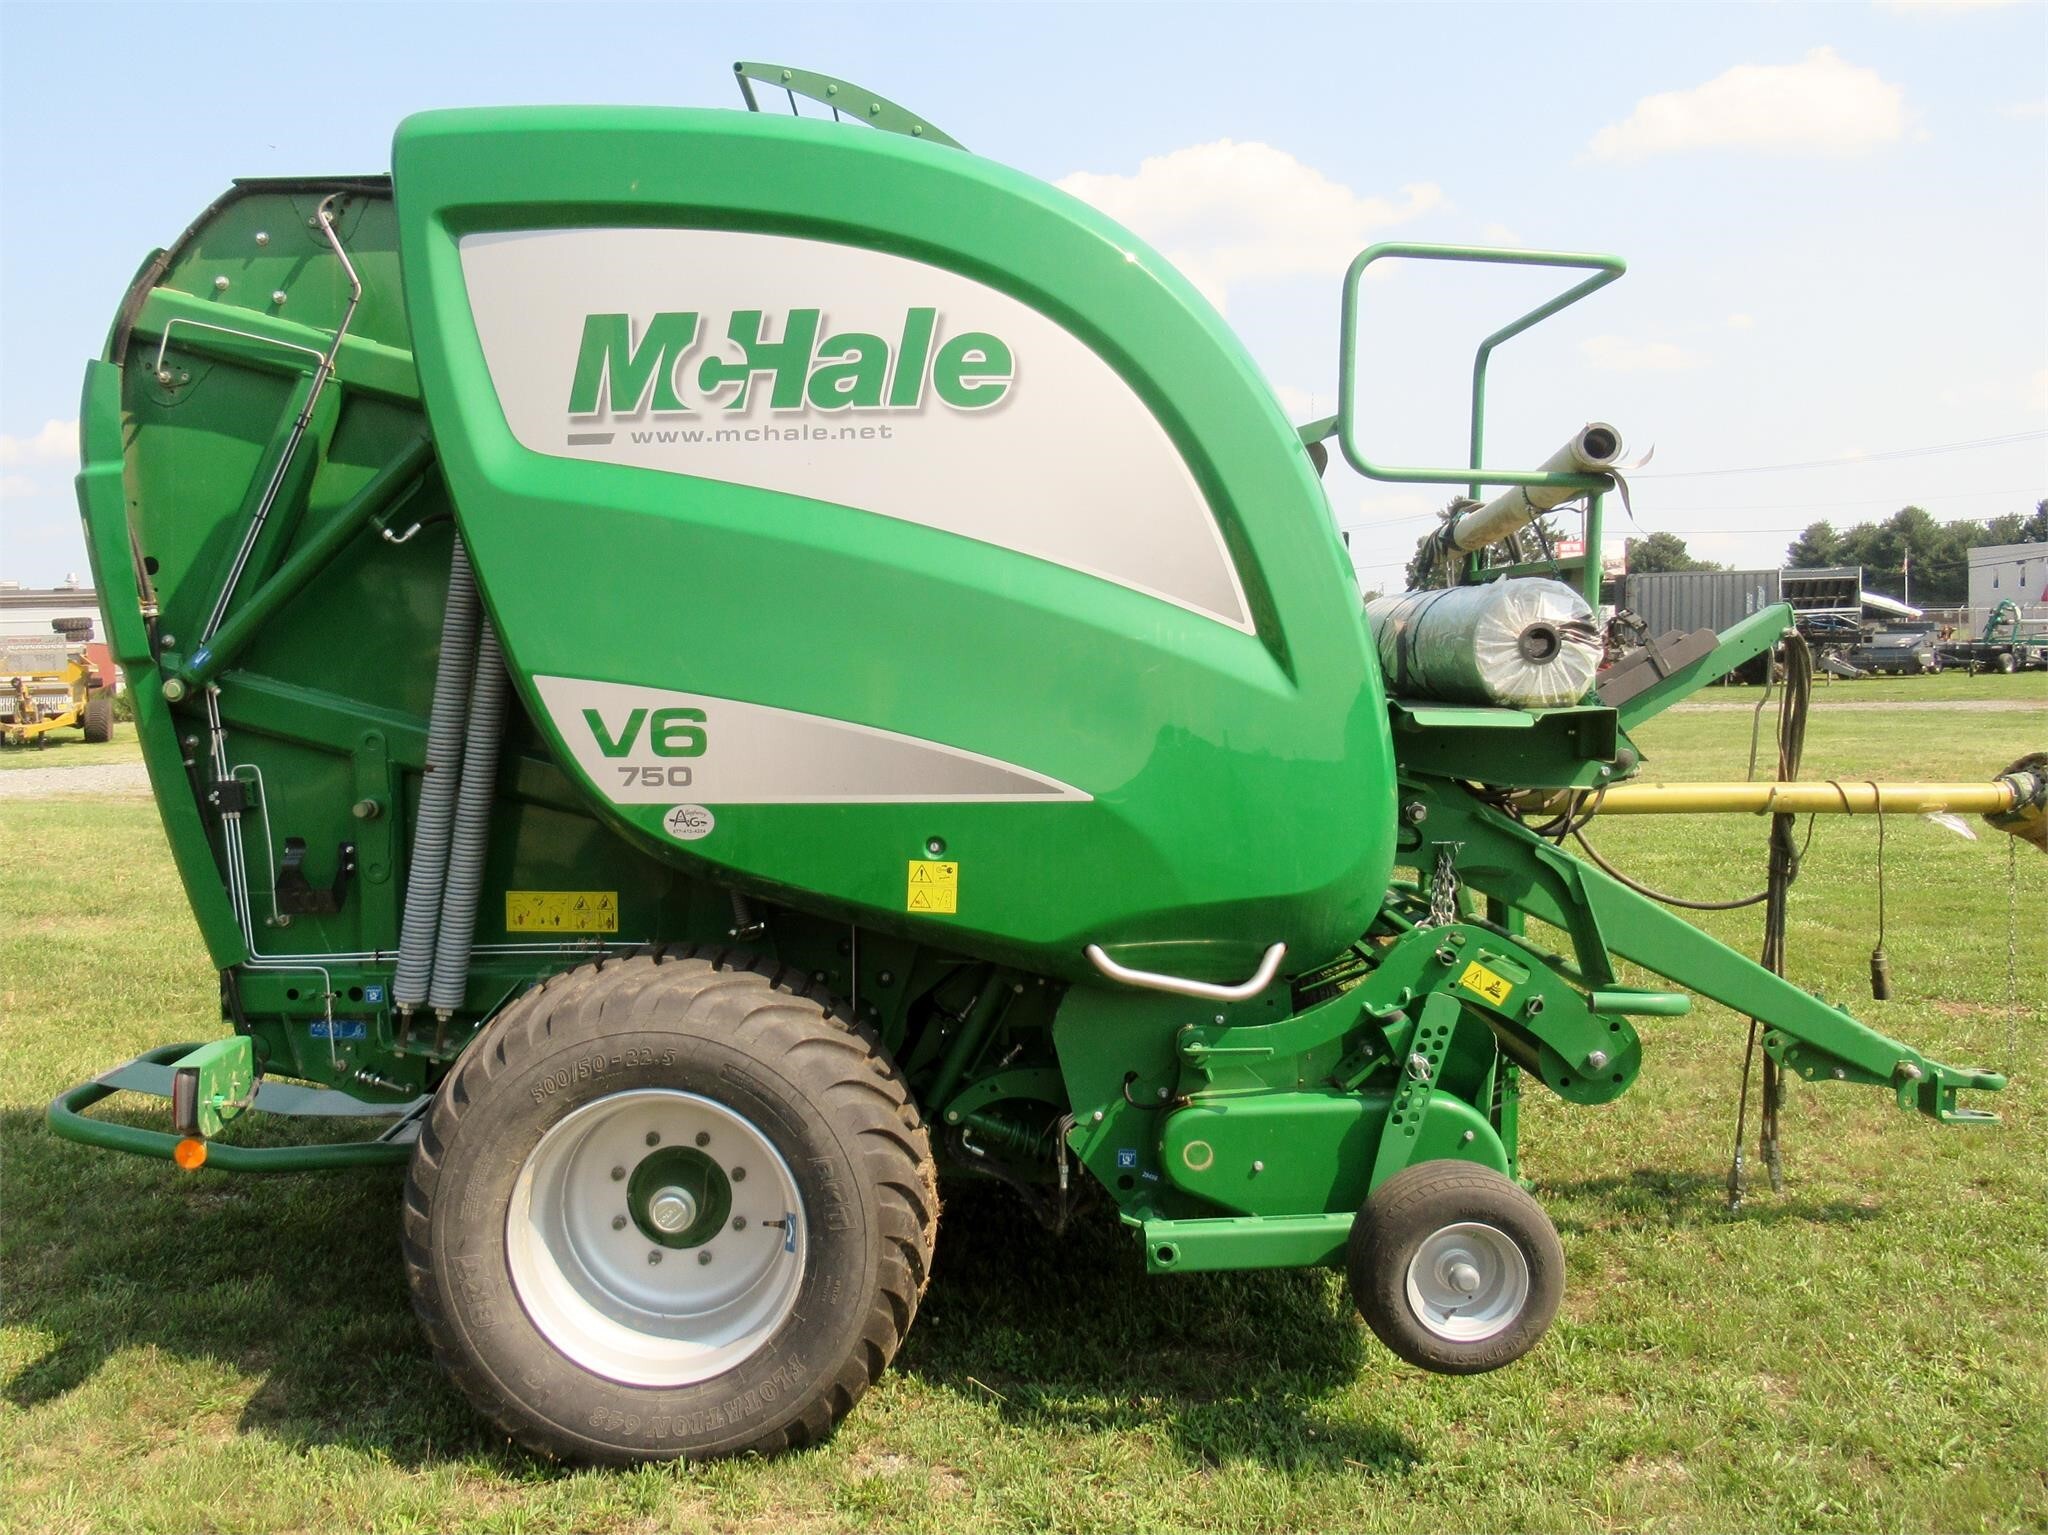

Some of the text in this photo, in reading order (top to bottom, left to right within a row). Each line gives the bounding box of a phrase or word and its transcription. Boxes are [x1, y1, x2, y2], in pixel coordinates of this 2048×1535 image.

[567, 306, 1015, 415] McHale
[631, 424, 893, 444] www.mchale.net
[581, 707, 708, 758] V6
[617, 766, 692, 787] 750
[589, 1352, 806, 1439] FLOTATION 648
